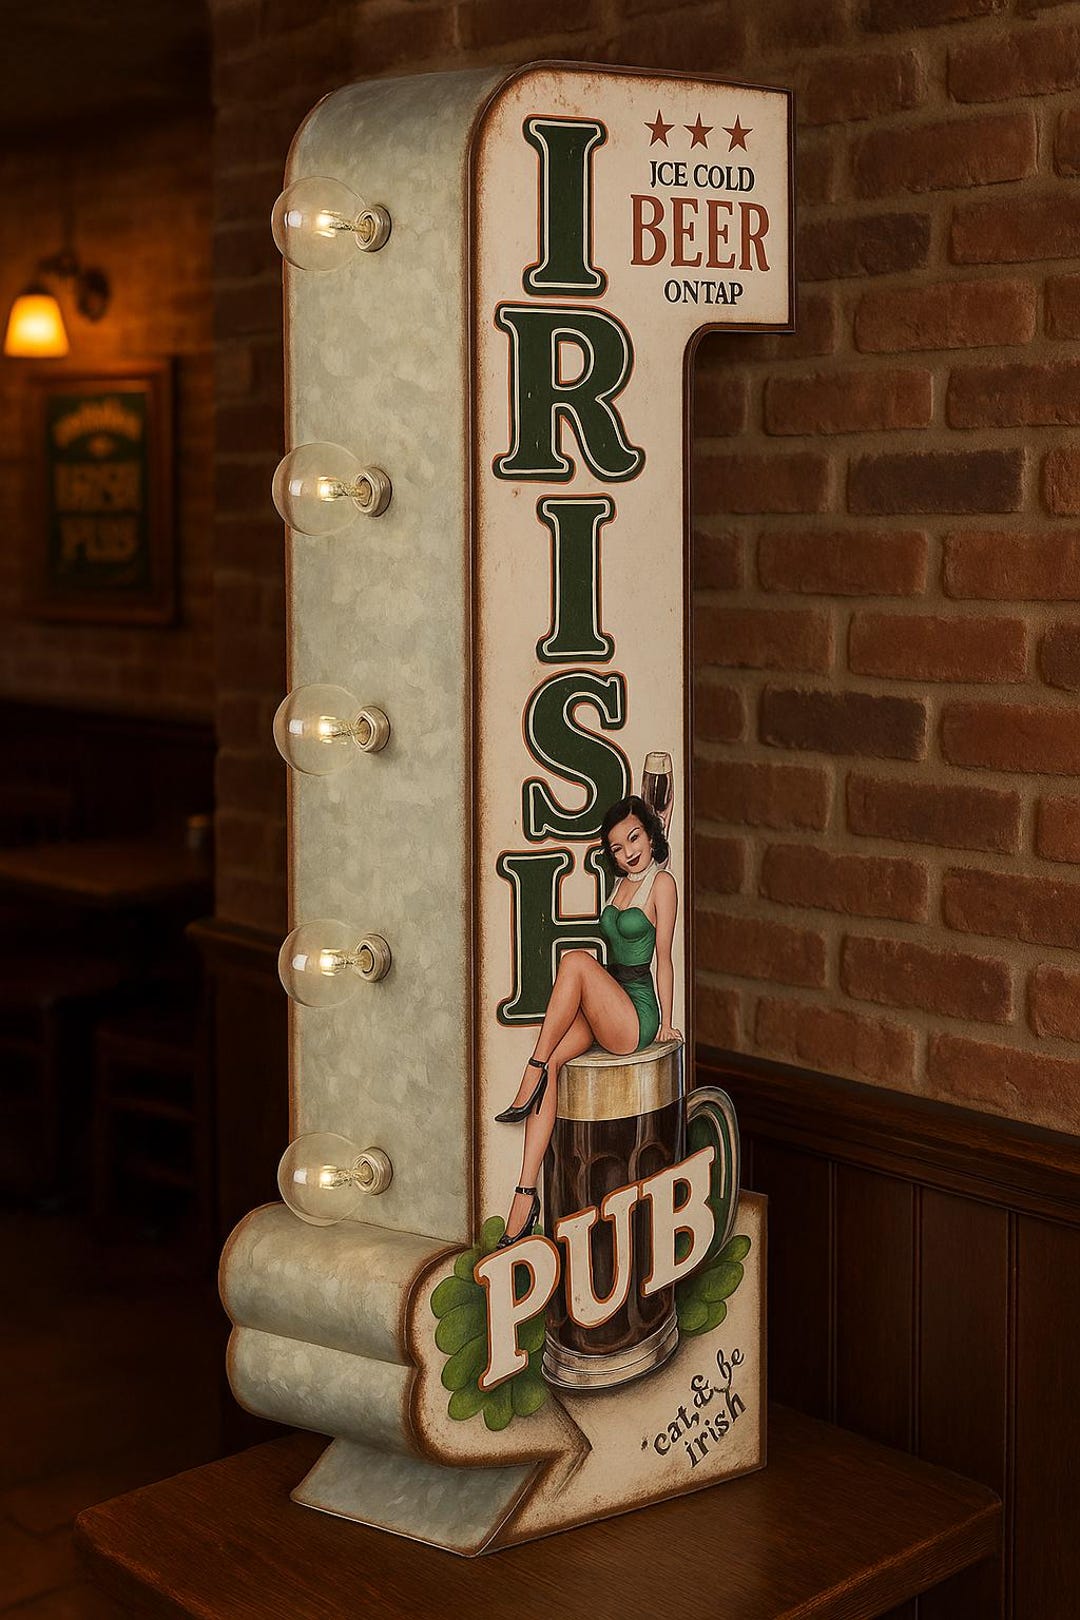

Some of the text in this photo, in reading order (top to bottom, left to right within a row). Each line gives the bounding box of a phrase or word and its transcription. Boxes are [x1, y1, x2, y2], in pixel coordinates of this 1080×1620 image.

[693, 164, 756, 193] COLD
[630, 193, 771, 272] BEER
[493, 114, 645, 1027] IRISH
[473, 1146, 716, 1392] PUB
[684, 1388, 747, 1469] irish
